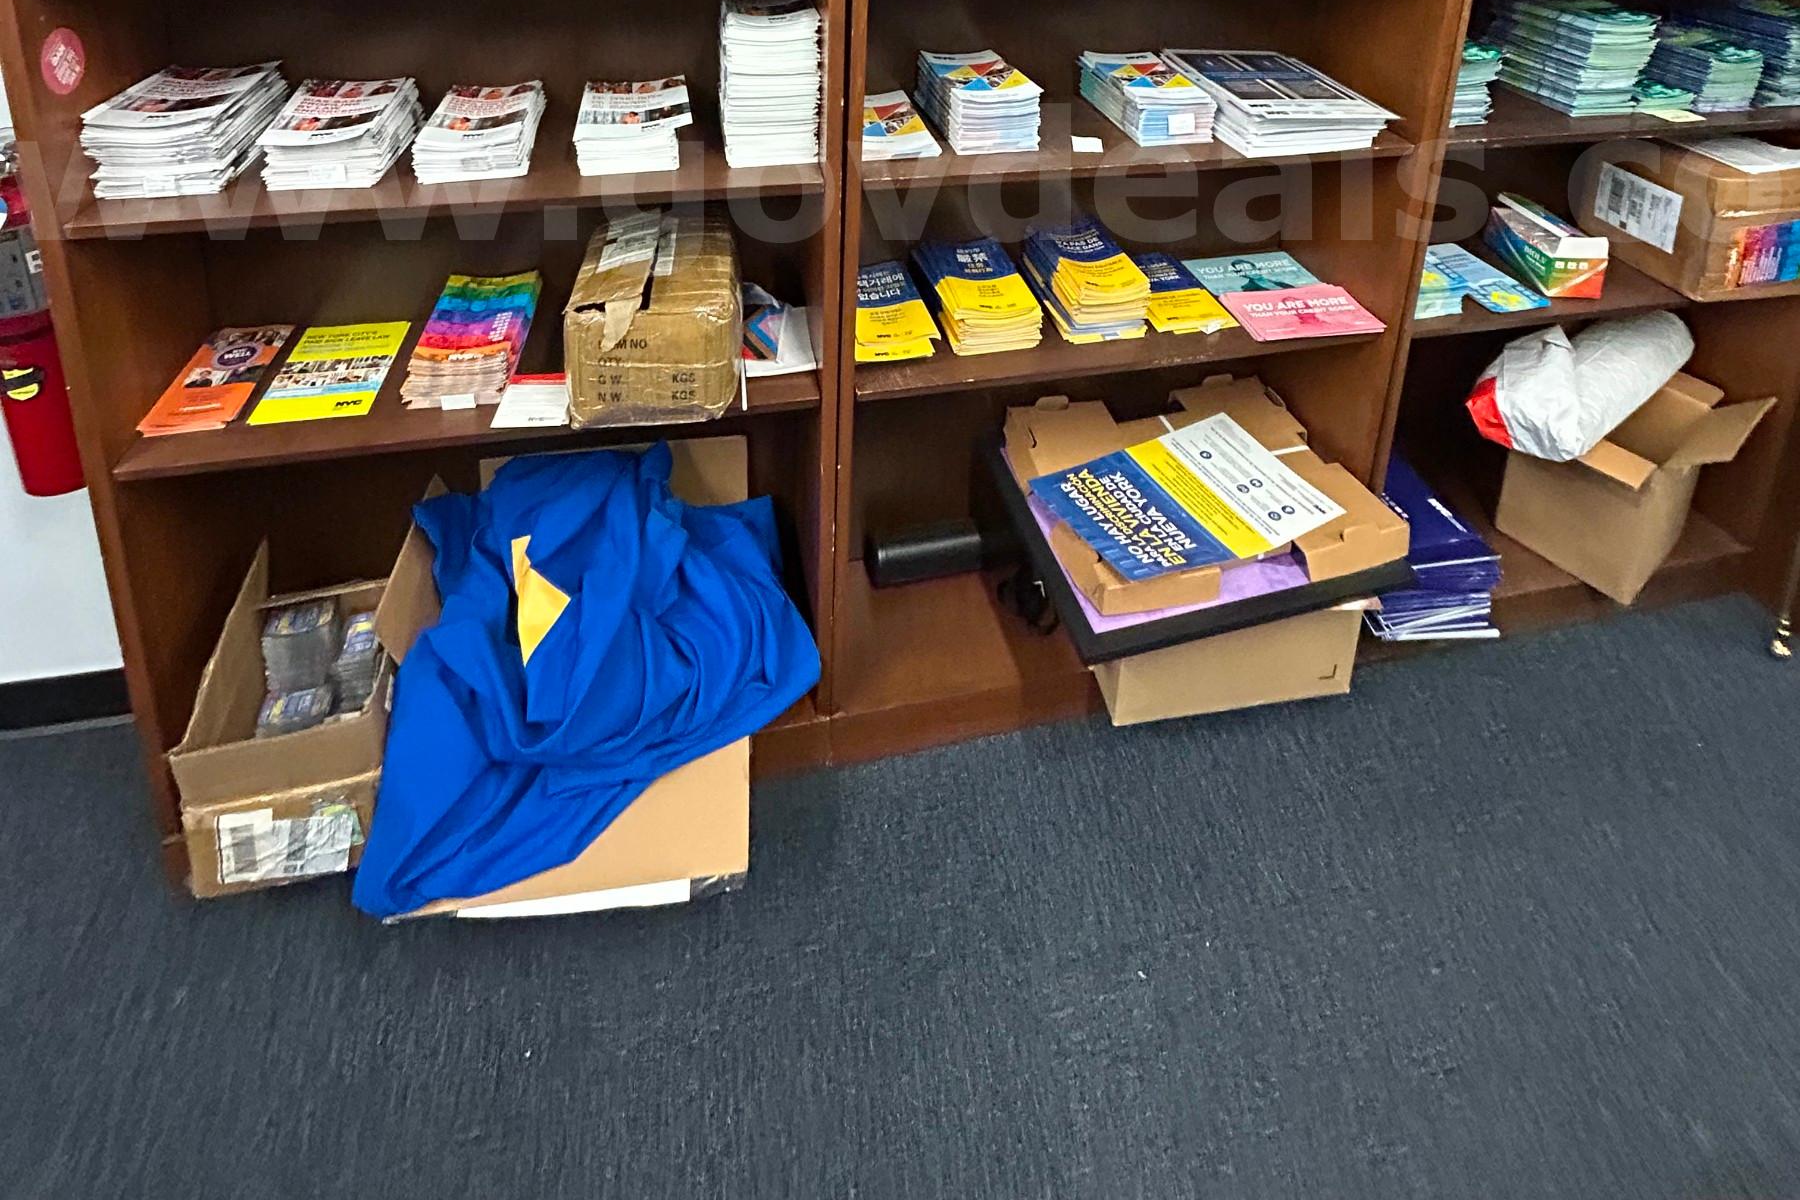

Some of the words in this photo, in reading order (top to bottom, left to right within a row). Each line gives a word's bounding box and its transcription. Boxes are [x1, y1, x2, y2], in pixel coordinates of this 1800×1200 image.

[1198, 267, 1224, 275] YOU
[1228, 263, 1253, 273] ARE
[1256, 260, 1292, 269] MORE
[1243, 303, 1274, 312] YOU
[1277, 300, 1306, 310] ARE
[1308, 296, 1349, 307] MORE
[223, 351, 252, 360] WELL
[672, 372, 696, 383] KGS
[335, 399, 363, 408] NYC
[672, 390, 697, 401] KGS
[1099, 476, 1117, 492] DE
[1110, 471, 1147, 507] YORK
[1060, 481, 1104, 522] LUGAR
[1066, 473, 1134, 535] DISCRIMINACIÓN
[1077, 468, 1141, 529] VIVIENDA
[1117, 494, 1152, 525] CIUDAD
[1098, 520, 1132, 545] HAY
[1147, 506, 1198, 550] NUEVA
[1152, 525, 1170, 539] LA
[1131, 535, 1147, 547] LA
[1139, 528, 1162, 547] LA
[1164, 538, 1184, 551] EN
[1128, 546, 1154, 564] NO
[1143, 546, 1172, 567] PARA
[1159, 547, 1187, 565] EN
